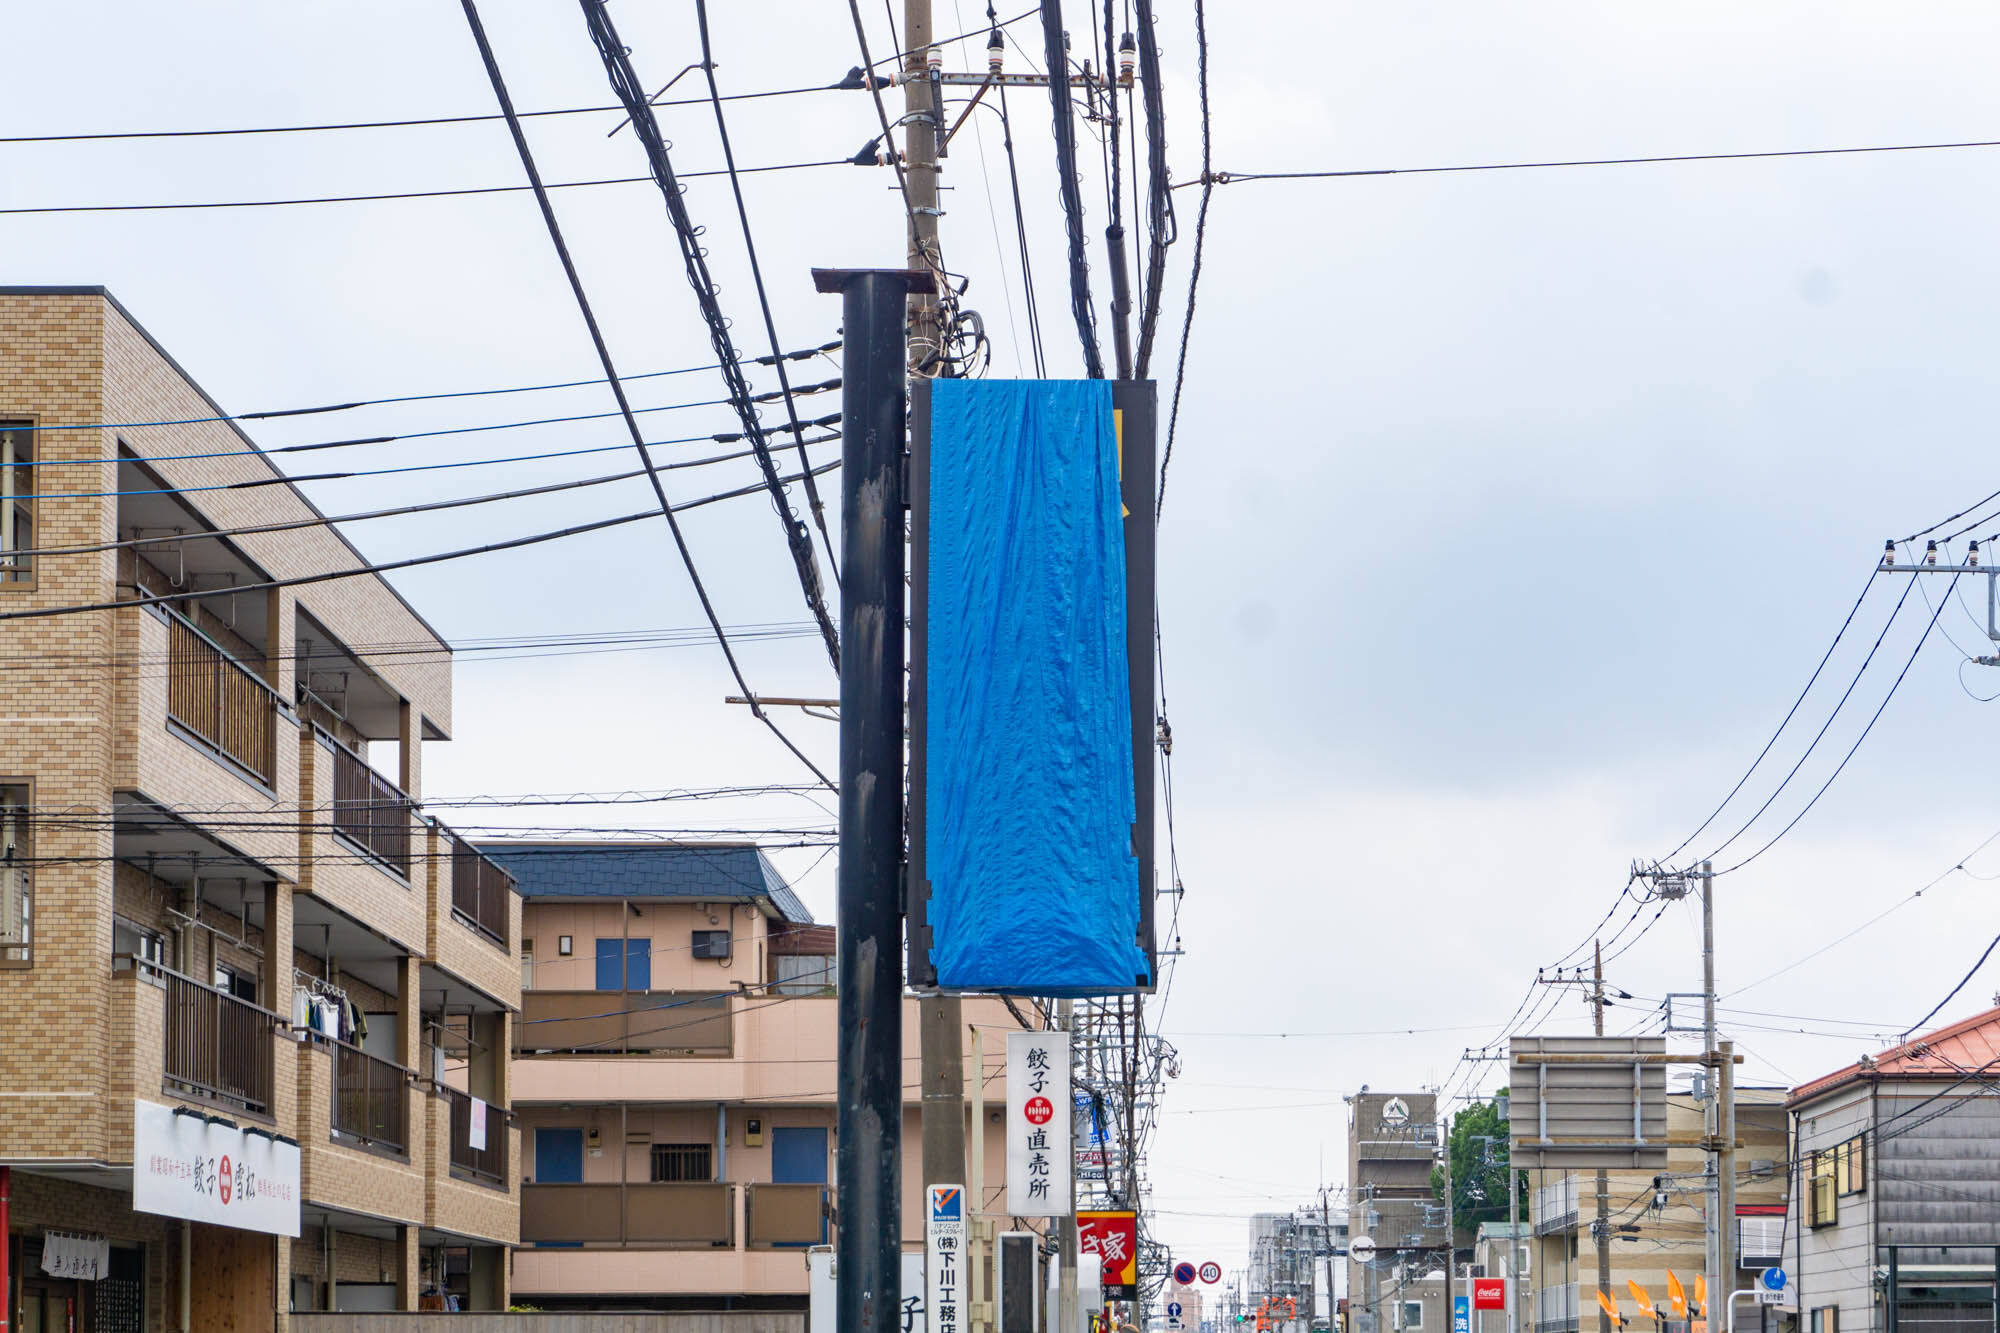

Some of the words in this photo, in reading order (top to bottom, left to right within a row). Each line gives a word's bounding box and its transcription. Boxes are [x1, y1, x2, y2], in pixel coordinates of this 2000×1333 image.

[1027, 1048, 1050, 1093] 餃子
[194, 1155, 216, 1196] 餃子
[235, 1162, 256, 1201] 雪松
[1027, 1128, 1050, 1200] 直売所
[1203, 1267, 1217, 1278] 40
[1477, 1288, 1501, 1297] Coca-Cola
[1456, 1318, 1467, 1333] 洗
